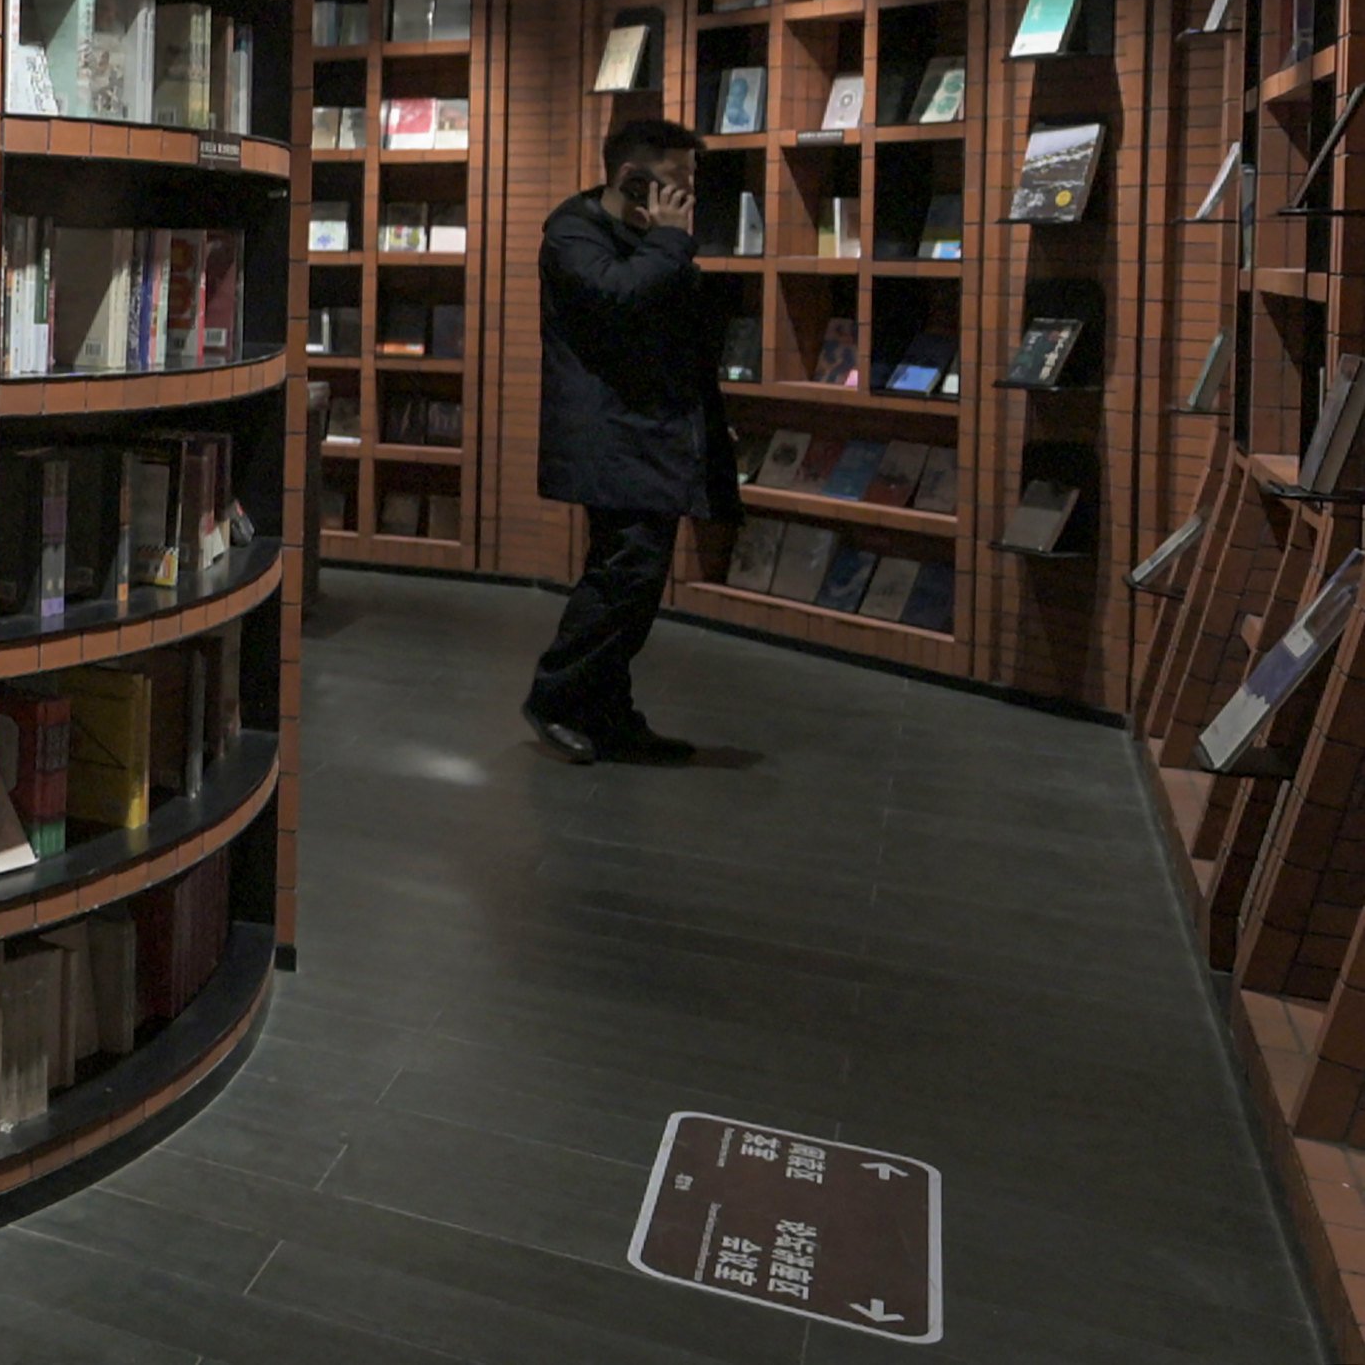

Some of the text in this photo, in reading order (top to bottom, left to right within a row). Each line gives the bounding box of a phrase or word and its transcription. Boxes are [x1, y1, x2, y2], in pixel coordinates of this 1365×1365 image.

[785, 1141, 826, 1185] 阅读区
[714, 1235, 763, 1287] 会议室
[767, 1218, 818, 1300] 论坛讲座区
